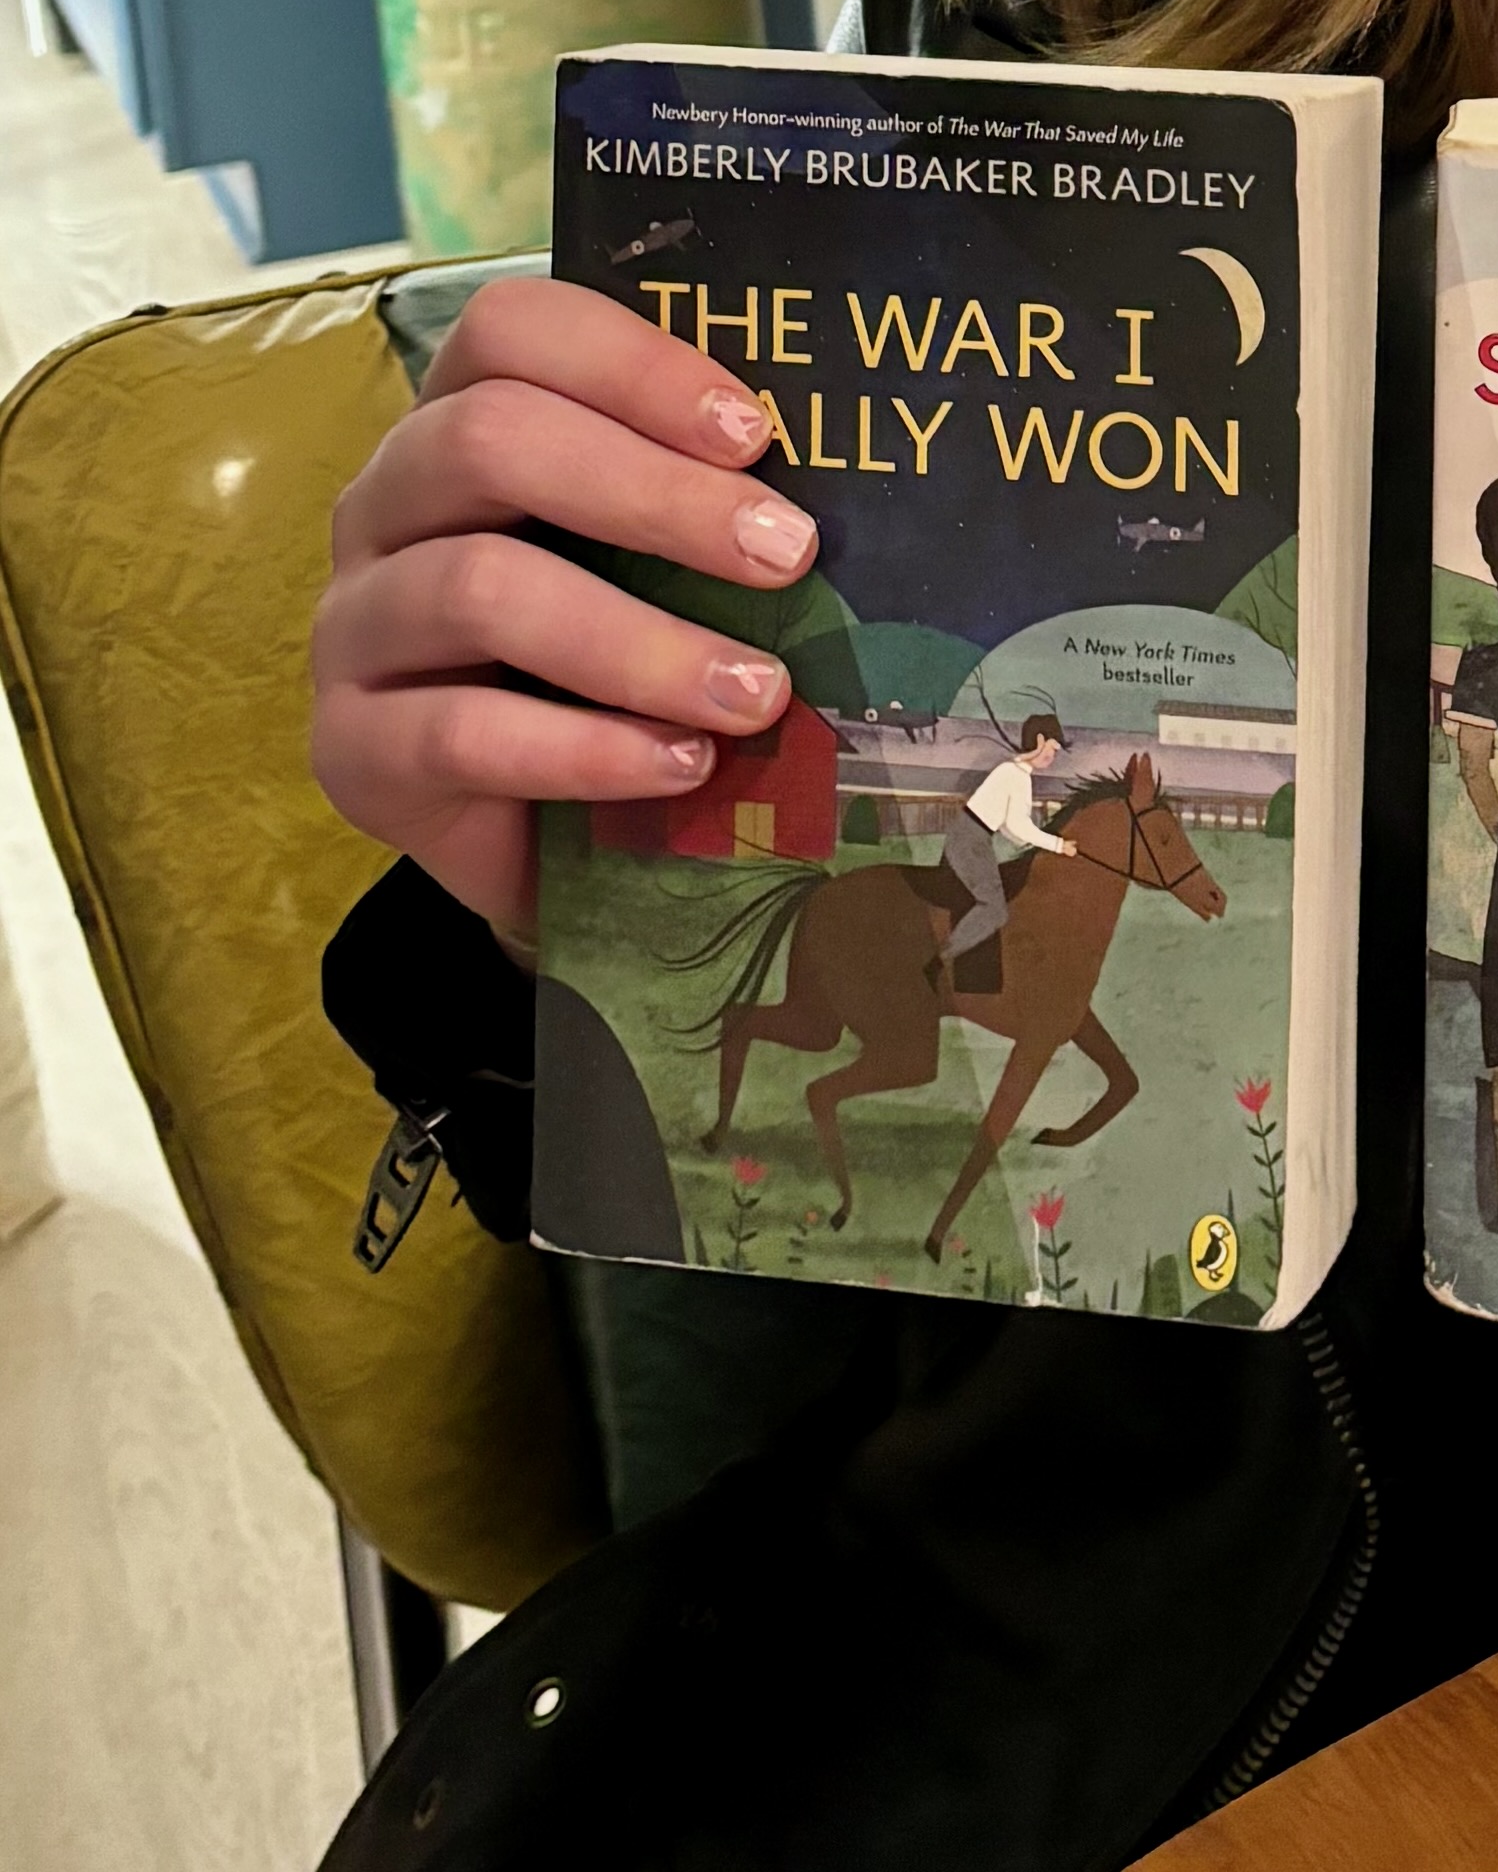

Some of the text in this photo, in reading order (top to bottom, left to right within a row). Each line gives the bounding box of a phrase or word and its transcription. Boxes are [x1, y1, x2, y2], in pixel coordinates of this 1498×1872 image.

[652, 101, 1184, 152] Newbery Honor-winning author of The War That Saved My Life
[586, 137, 1255, 209] KIMBERLY BRUBAKER BRADLEY
[640, 280, 1154, 385] THE WAR I
[757, 389, 1239, 496] ALLY WON
[1063, 636, 1236, 665] A New York Times
[1102, 661, 1195, 686] bestseller
